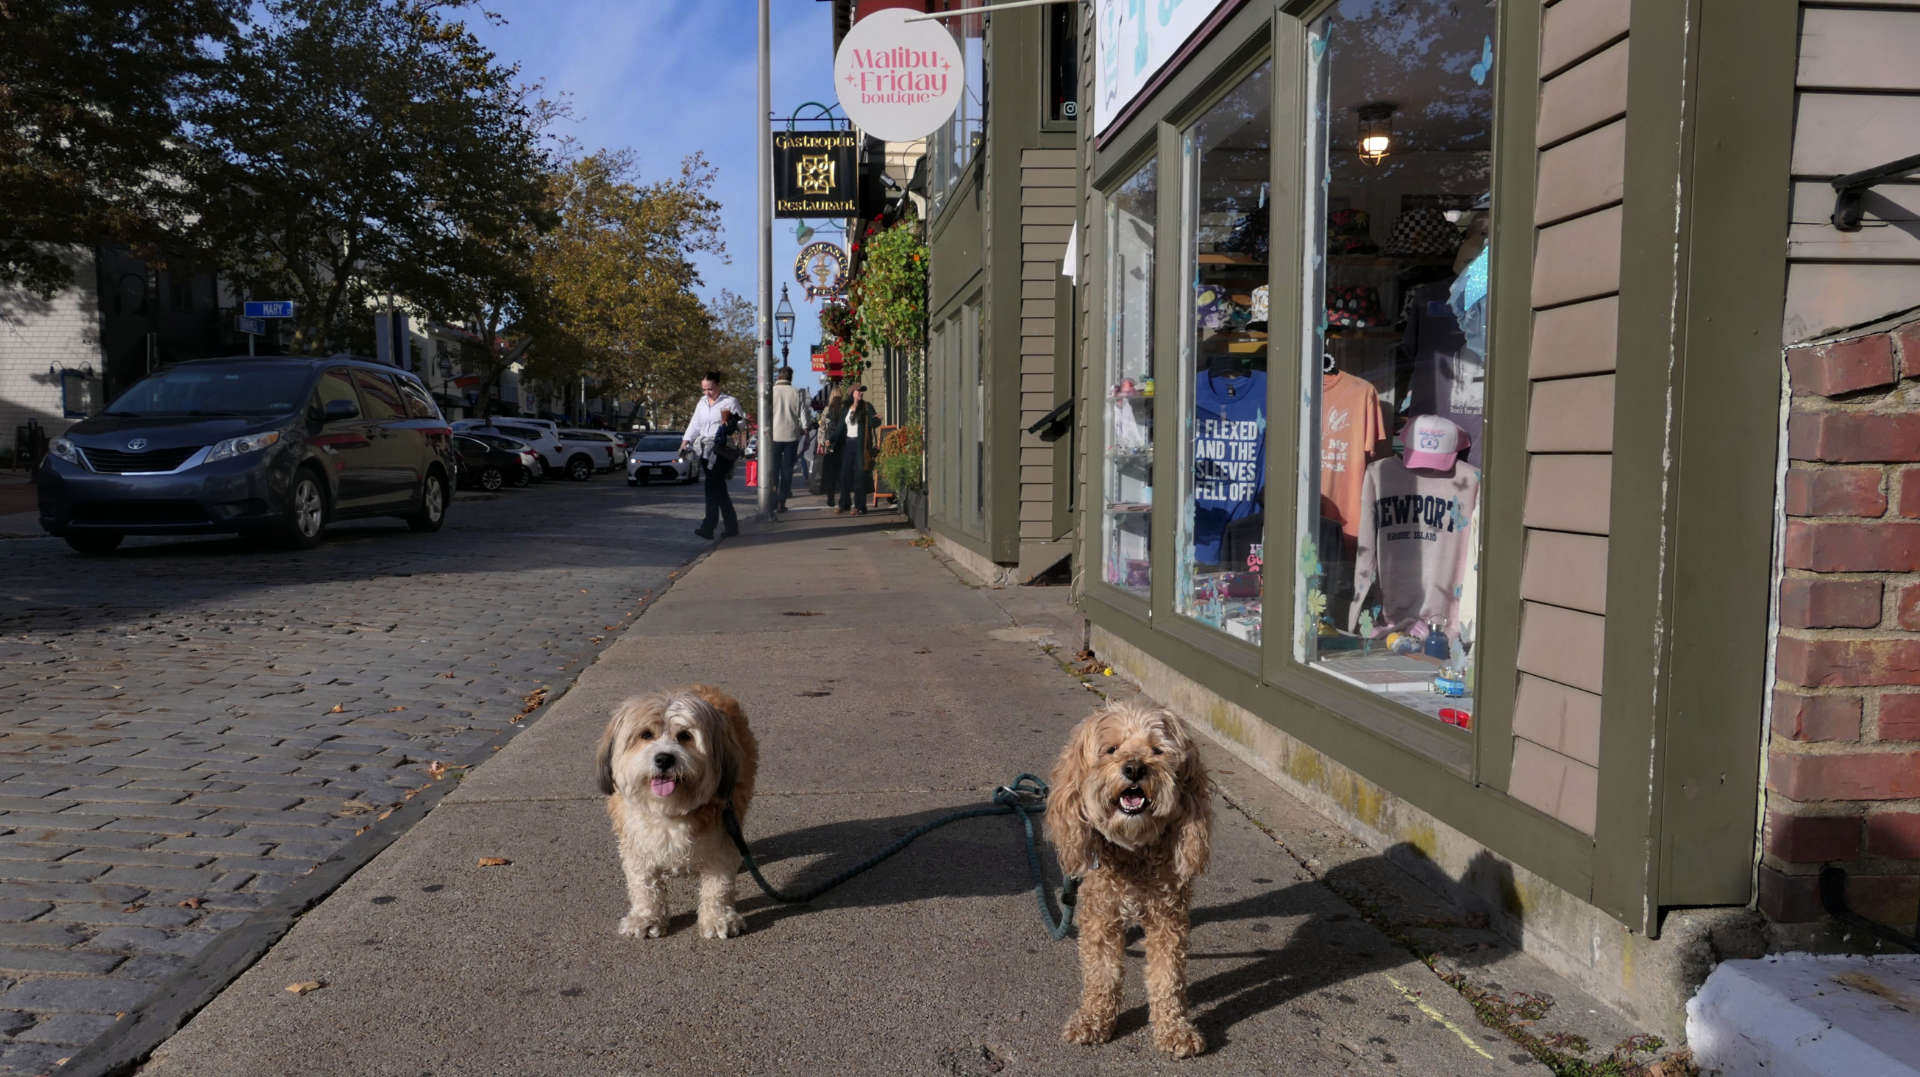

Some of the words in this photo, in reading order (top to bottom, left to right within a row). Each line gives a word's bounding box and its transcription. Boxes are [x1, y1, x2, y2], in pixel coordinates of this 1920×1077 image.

[853, 46, 938, 69] Malibu
[860, 69, 947, 97] Friday
[861, 91, 932, 105] boutique
[263, 303, 283, 315] MARY
[1195, 418, 1201, 438] I
[1204, 418, 1258, 441] FLEXED
[1195, 439, 1226, 460] AND
[1228, 441, 1257, 461] THE
[1195, 459, 1257, 481] SLEEVES
[1195, 480, 1228, 500] FELL
[1229, 481, 1256, 502] OFF
